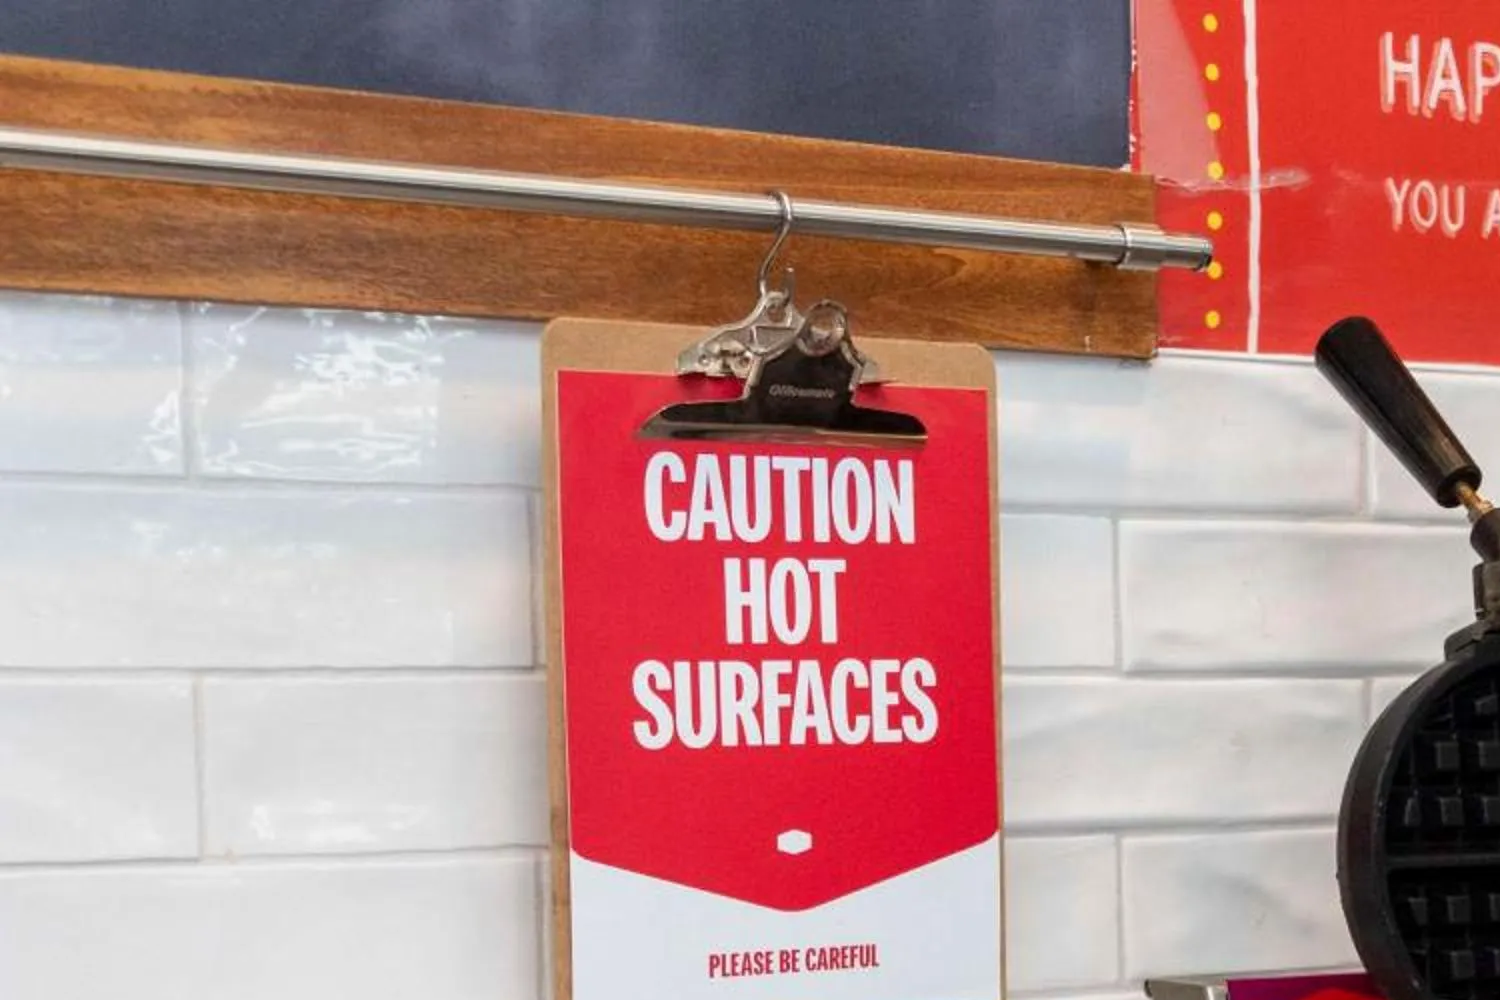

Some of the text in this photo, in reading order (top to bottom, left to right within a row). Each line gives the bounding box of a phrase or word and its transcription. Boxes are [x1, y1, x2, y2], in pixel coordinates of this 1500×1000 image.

[1385, 176, 1466, 238] YOU
[643, 452, 916, 544] CAUTION
[723, 557, 846, 645] HOT
[632, 657, 938, 750] SURFACES
[709, 944, 880, 979] PLEASE BE CAREFUL
